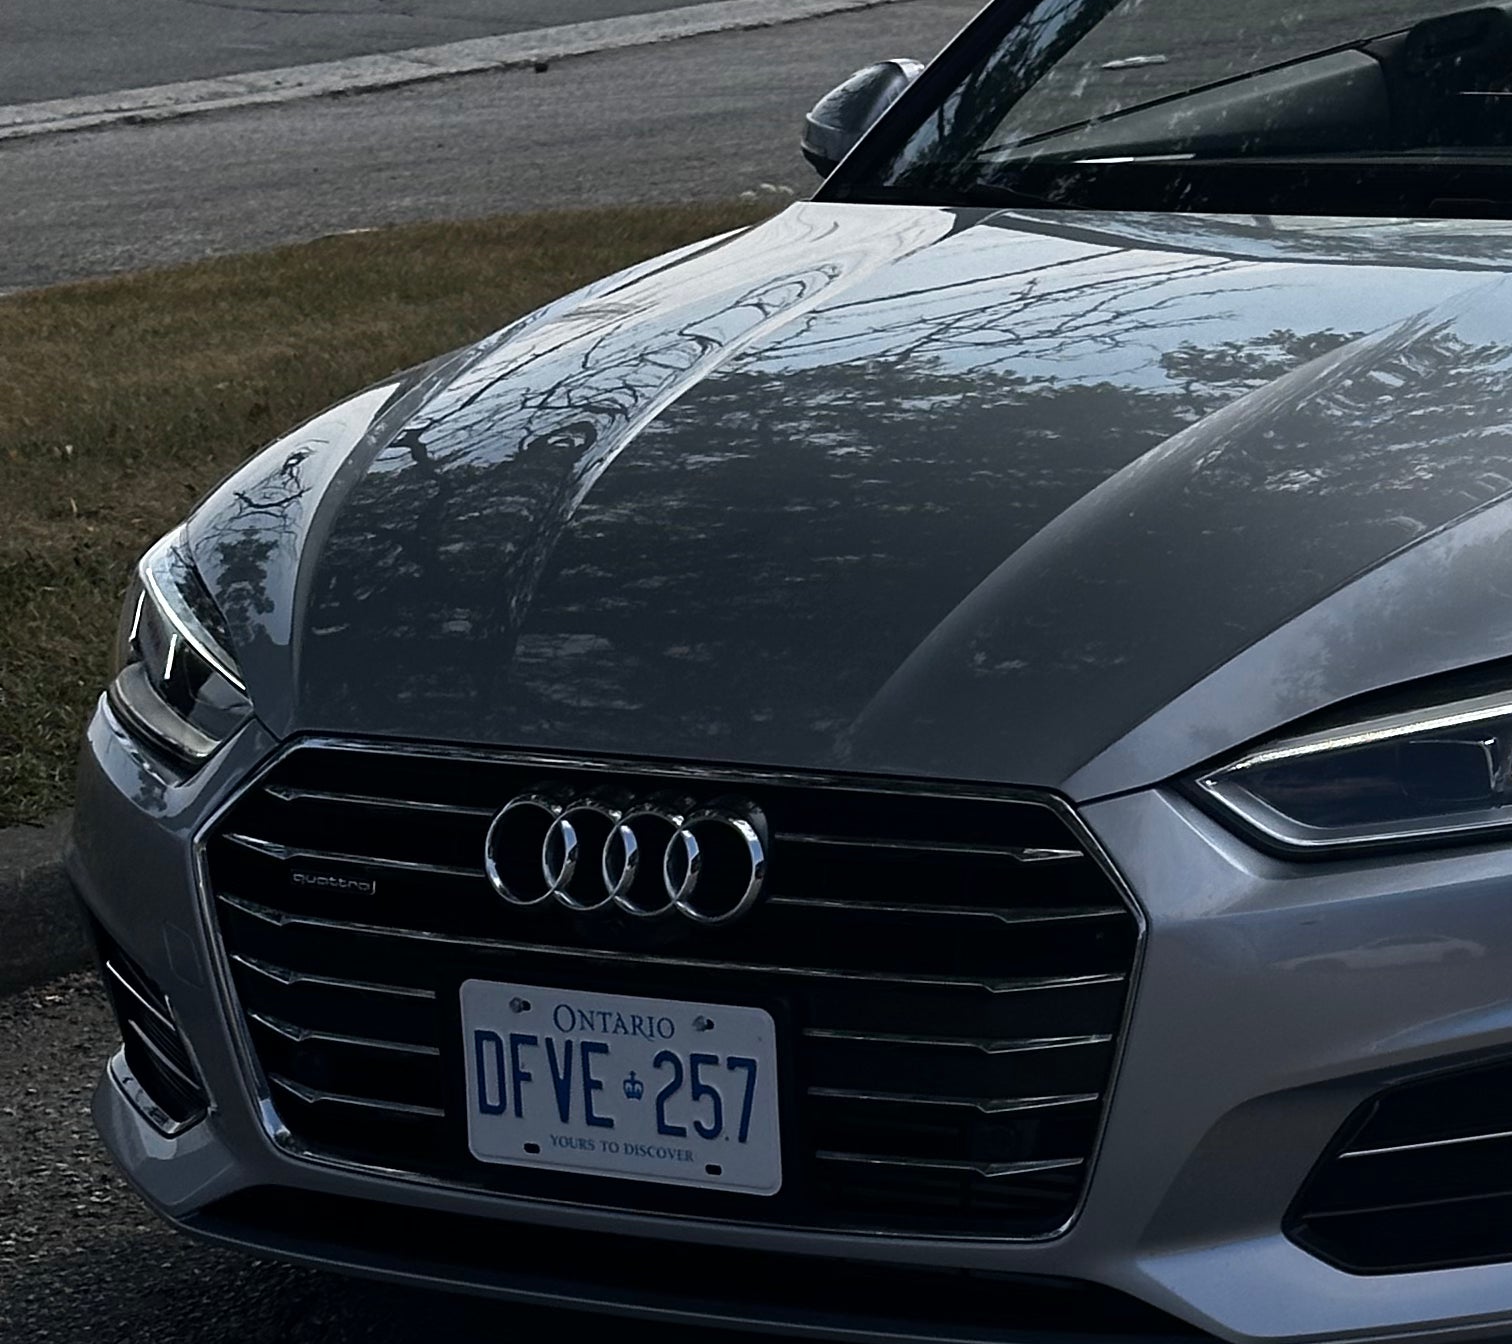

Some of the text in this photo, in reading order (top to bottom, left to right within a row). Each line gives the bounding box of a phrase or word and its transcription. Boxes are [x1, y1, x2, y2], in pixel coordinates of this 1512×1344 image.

[293, 873, 370, 892] quattro
[552, 1004, 675, 1041] ONTARIO
[474, 1029, 758, 1144] DFVE 257
[550, 1133, 695, 1164] YOURS TO DISCOVER
